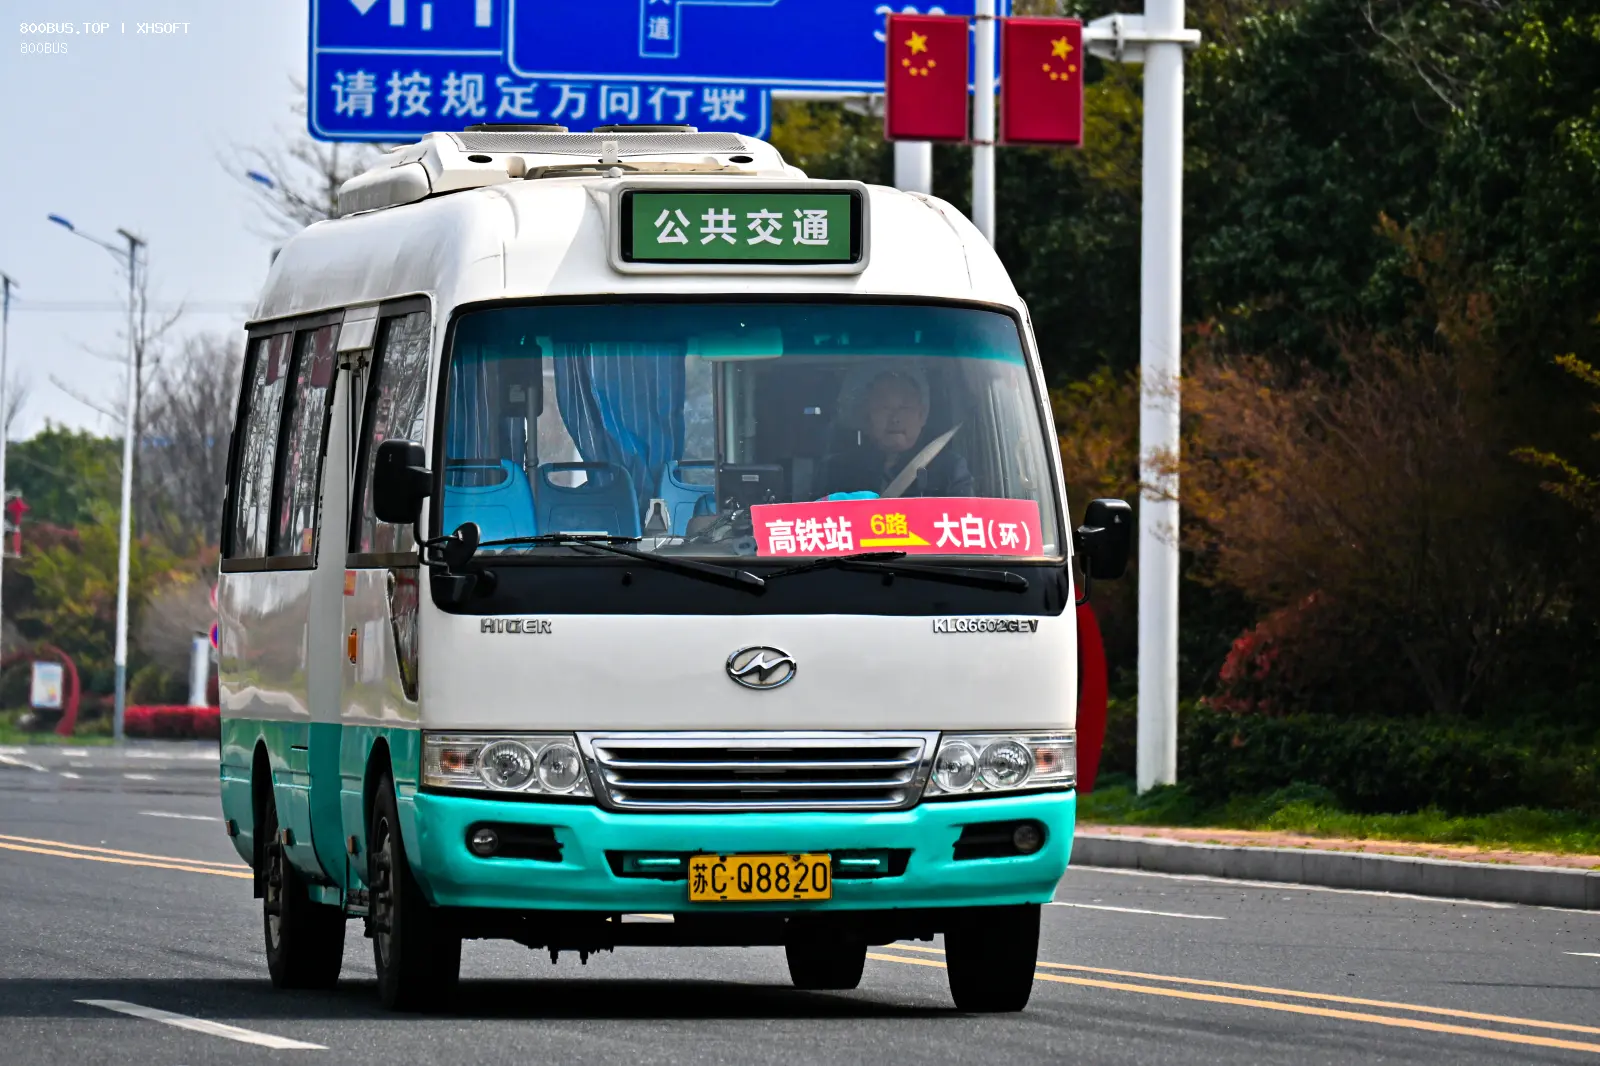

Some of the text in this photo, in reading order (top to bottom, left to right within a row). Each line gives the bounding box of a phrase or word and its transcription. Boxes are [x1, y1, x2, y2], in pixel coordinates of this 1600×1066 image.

[331, 70, 748, 121] 请按规定方向行驶
[654, 208, 830, 246] 公共交通
[765, 516, 853, 554] 高铁站
[870, 513, 909, 536] 6路
[480, 618, 552, 634] HIGER
[933, 619, 1039, 633] KLQ6602GEV
